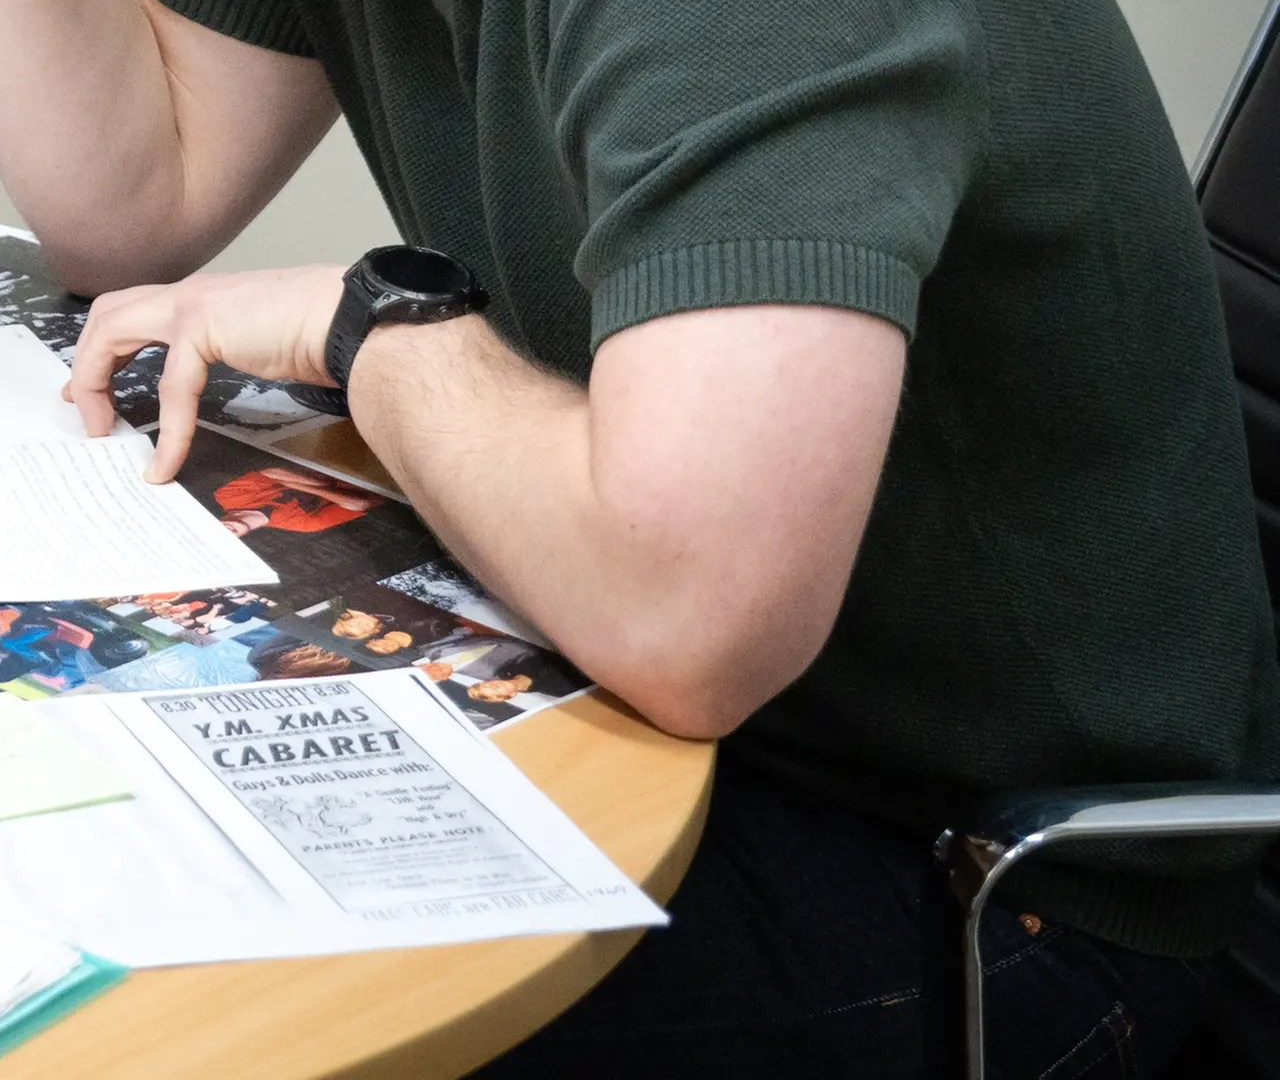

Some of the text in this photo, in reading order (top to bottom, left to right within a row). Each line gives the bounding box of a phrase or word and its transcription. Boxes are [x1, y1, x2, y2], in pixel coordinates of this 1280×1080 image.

[160, 700, 197, 714] 8.30
[313, 683, 350, 698] 8.30
[193, 705, 370, 739] Y.M. XMAS
[211, 729, 402, 768] CABARET
[232, 761, 435, 792] Guys & Dolls Dance with:
[301, 838, 374, 853] PARENTS
[379, 832, 437, 844] PLEASE
